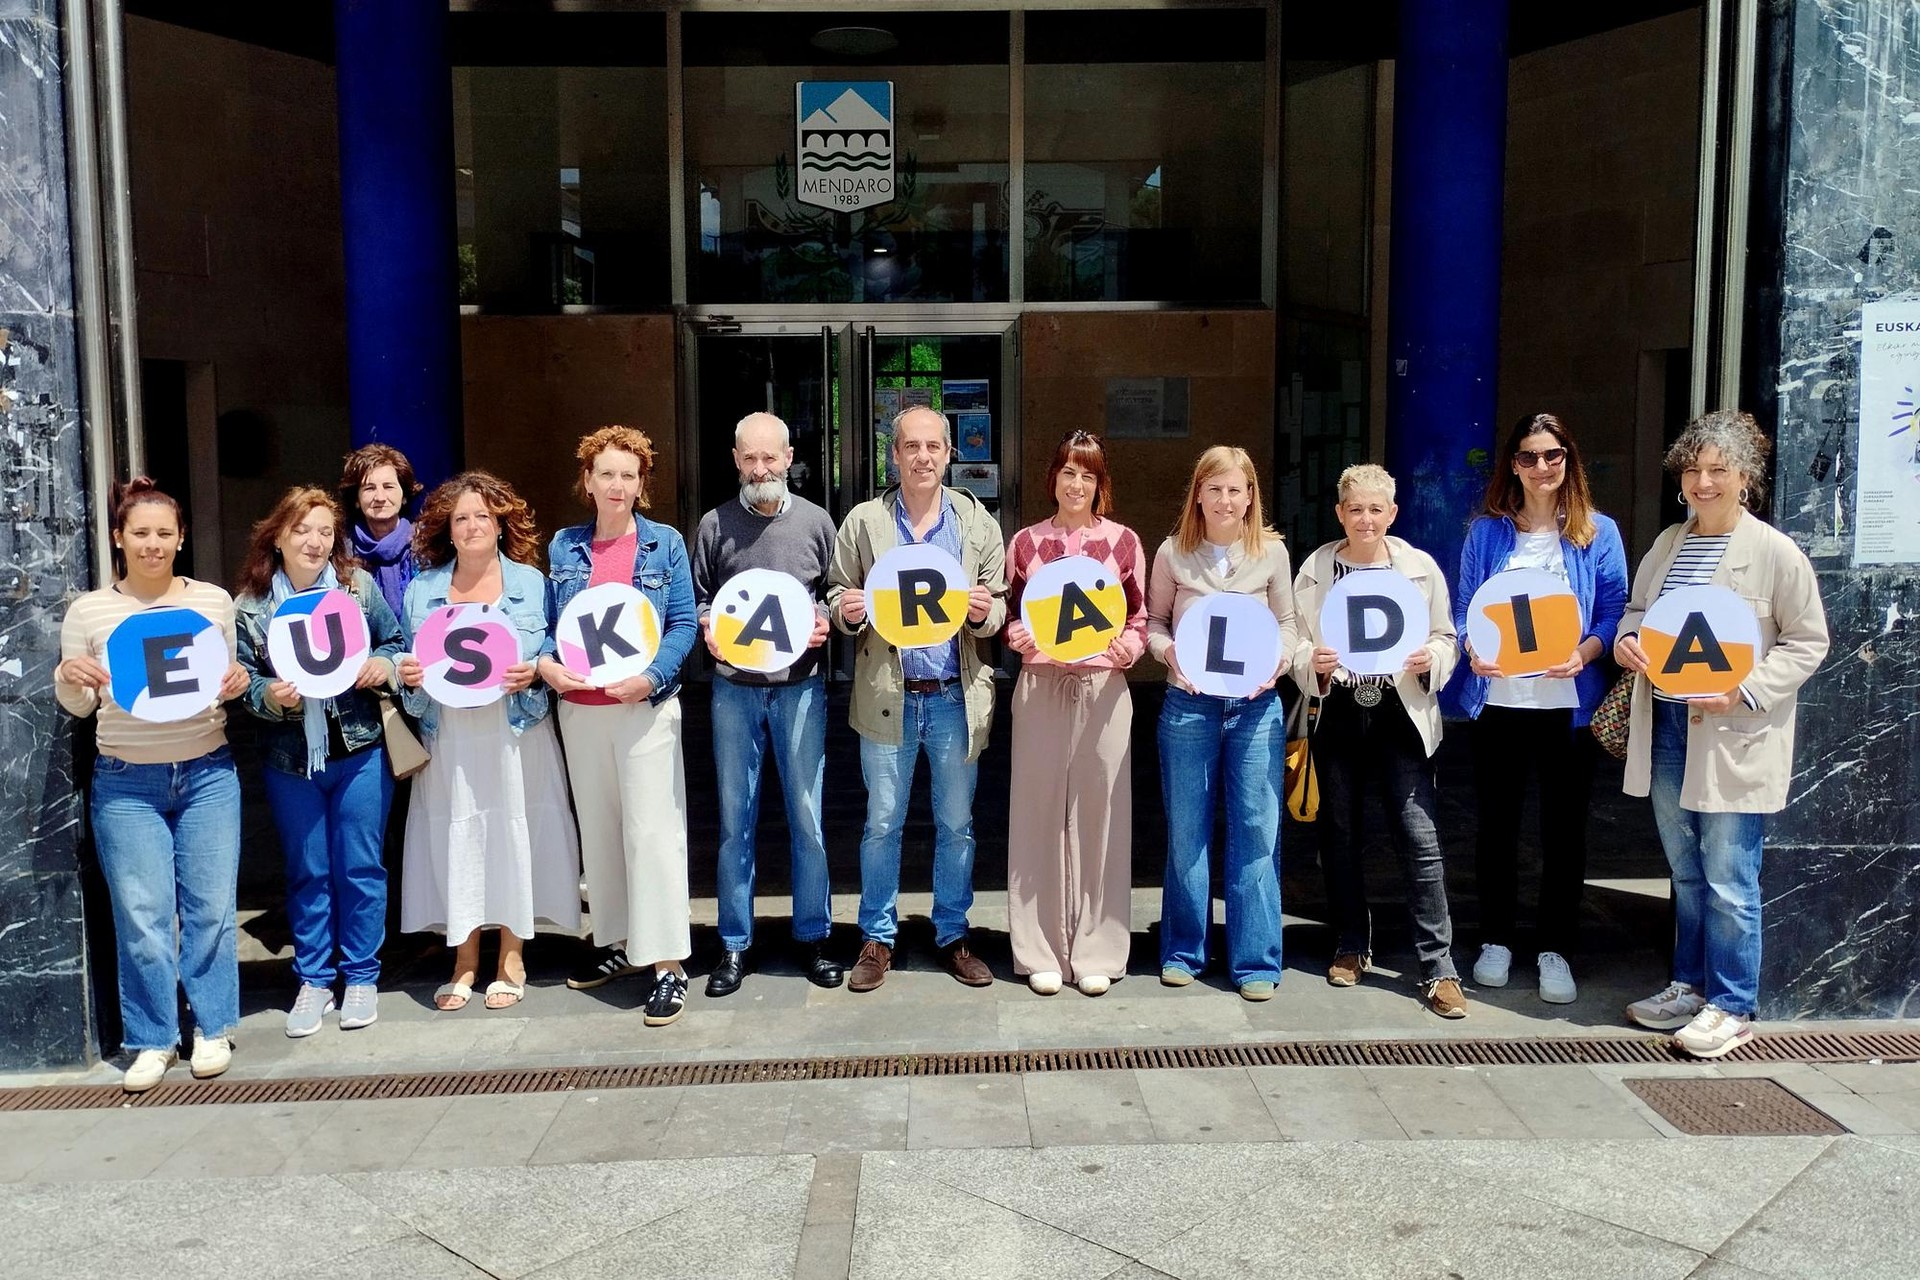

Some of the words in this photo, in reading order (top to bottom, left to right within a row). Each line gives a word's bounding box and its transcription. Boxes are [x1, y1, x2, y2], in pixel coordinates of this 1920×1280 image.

[803, 178, 891, 194] MENDARO
[833, 194, 860, 205] 1983
[733, 593, 794, 654] A
[897, 568, 951, 627] R
[1054, 581, 1113, 645] A
[1346, 594, 1405, 654] D
[1510, 593, 1538, 653] I
[288, 612, 346, 677] U
[443, 626, 493, 686] S
[577, 601, 641, 668] K
[1205, 615, 1245, 676] L
[1660, 611, 1732, 674] A
[142, 632, 200, 699] E
